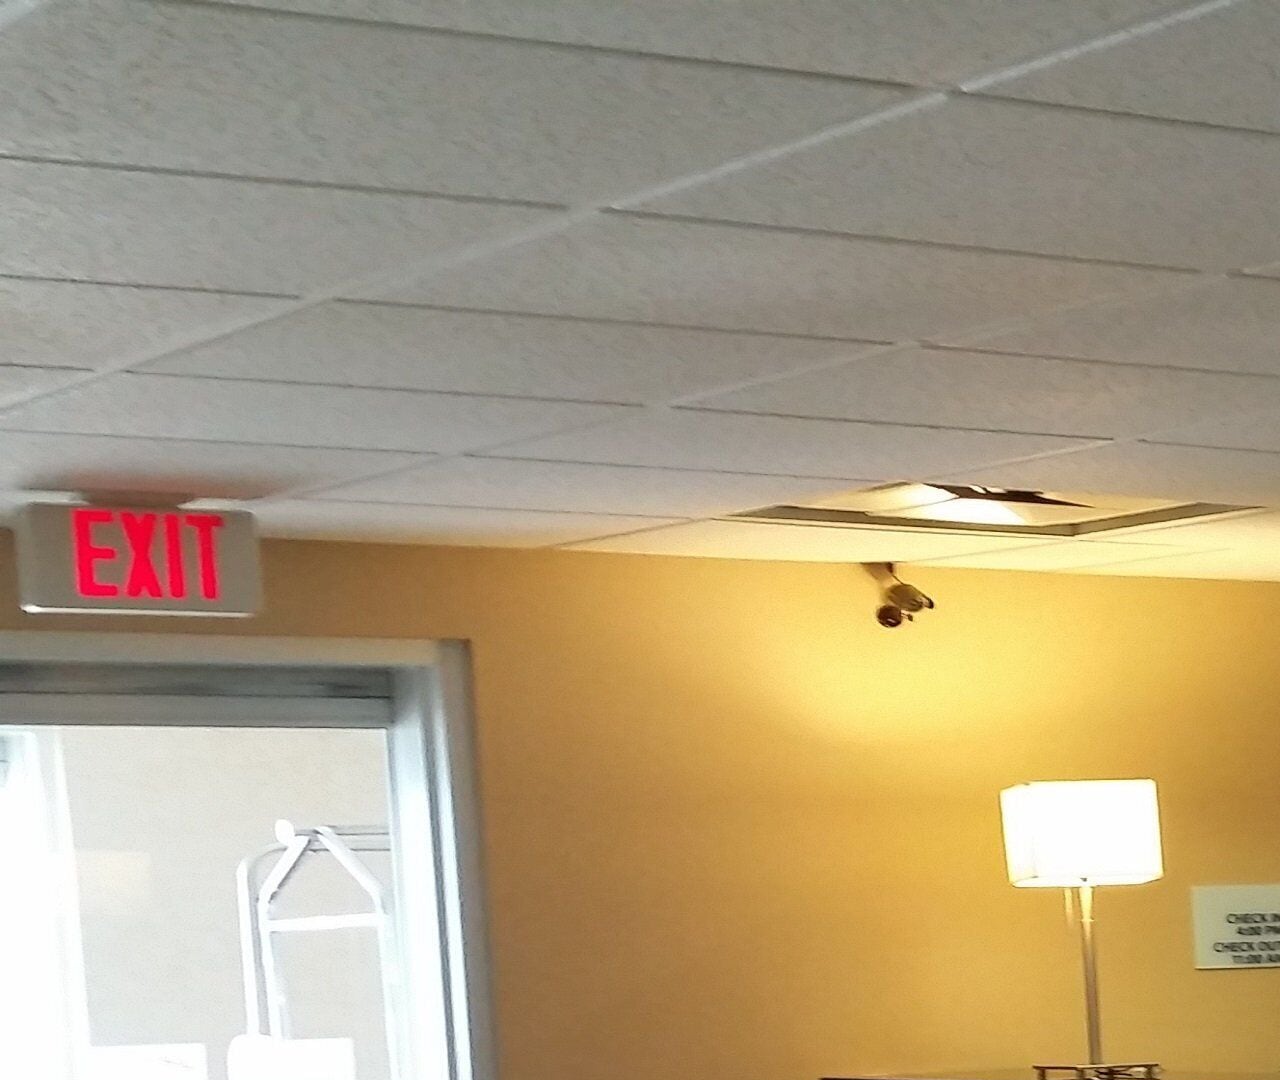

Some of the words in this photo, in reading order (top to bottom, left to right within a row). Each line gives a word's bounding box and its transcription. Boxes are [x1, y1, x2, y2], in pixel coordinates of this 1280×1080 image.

[73, 509, 224, 600] EXIT
[1226, 913, 1268, 923] CHECK
[1213, 942, 1255, 953] CHECK
